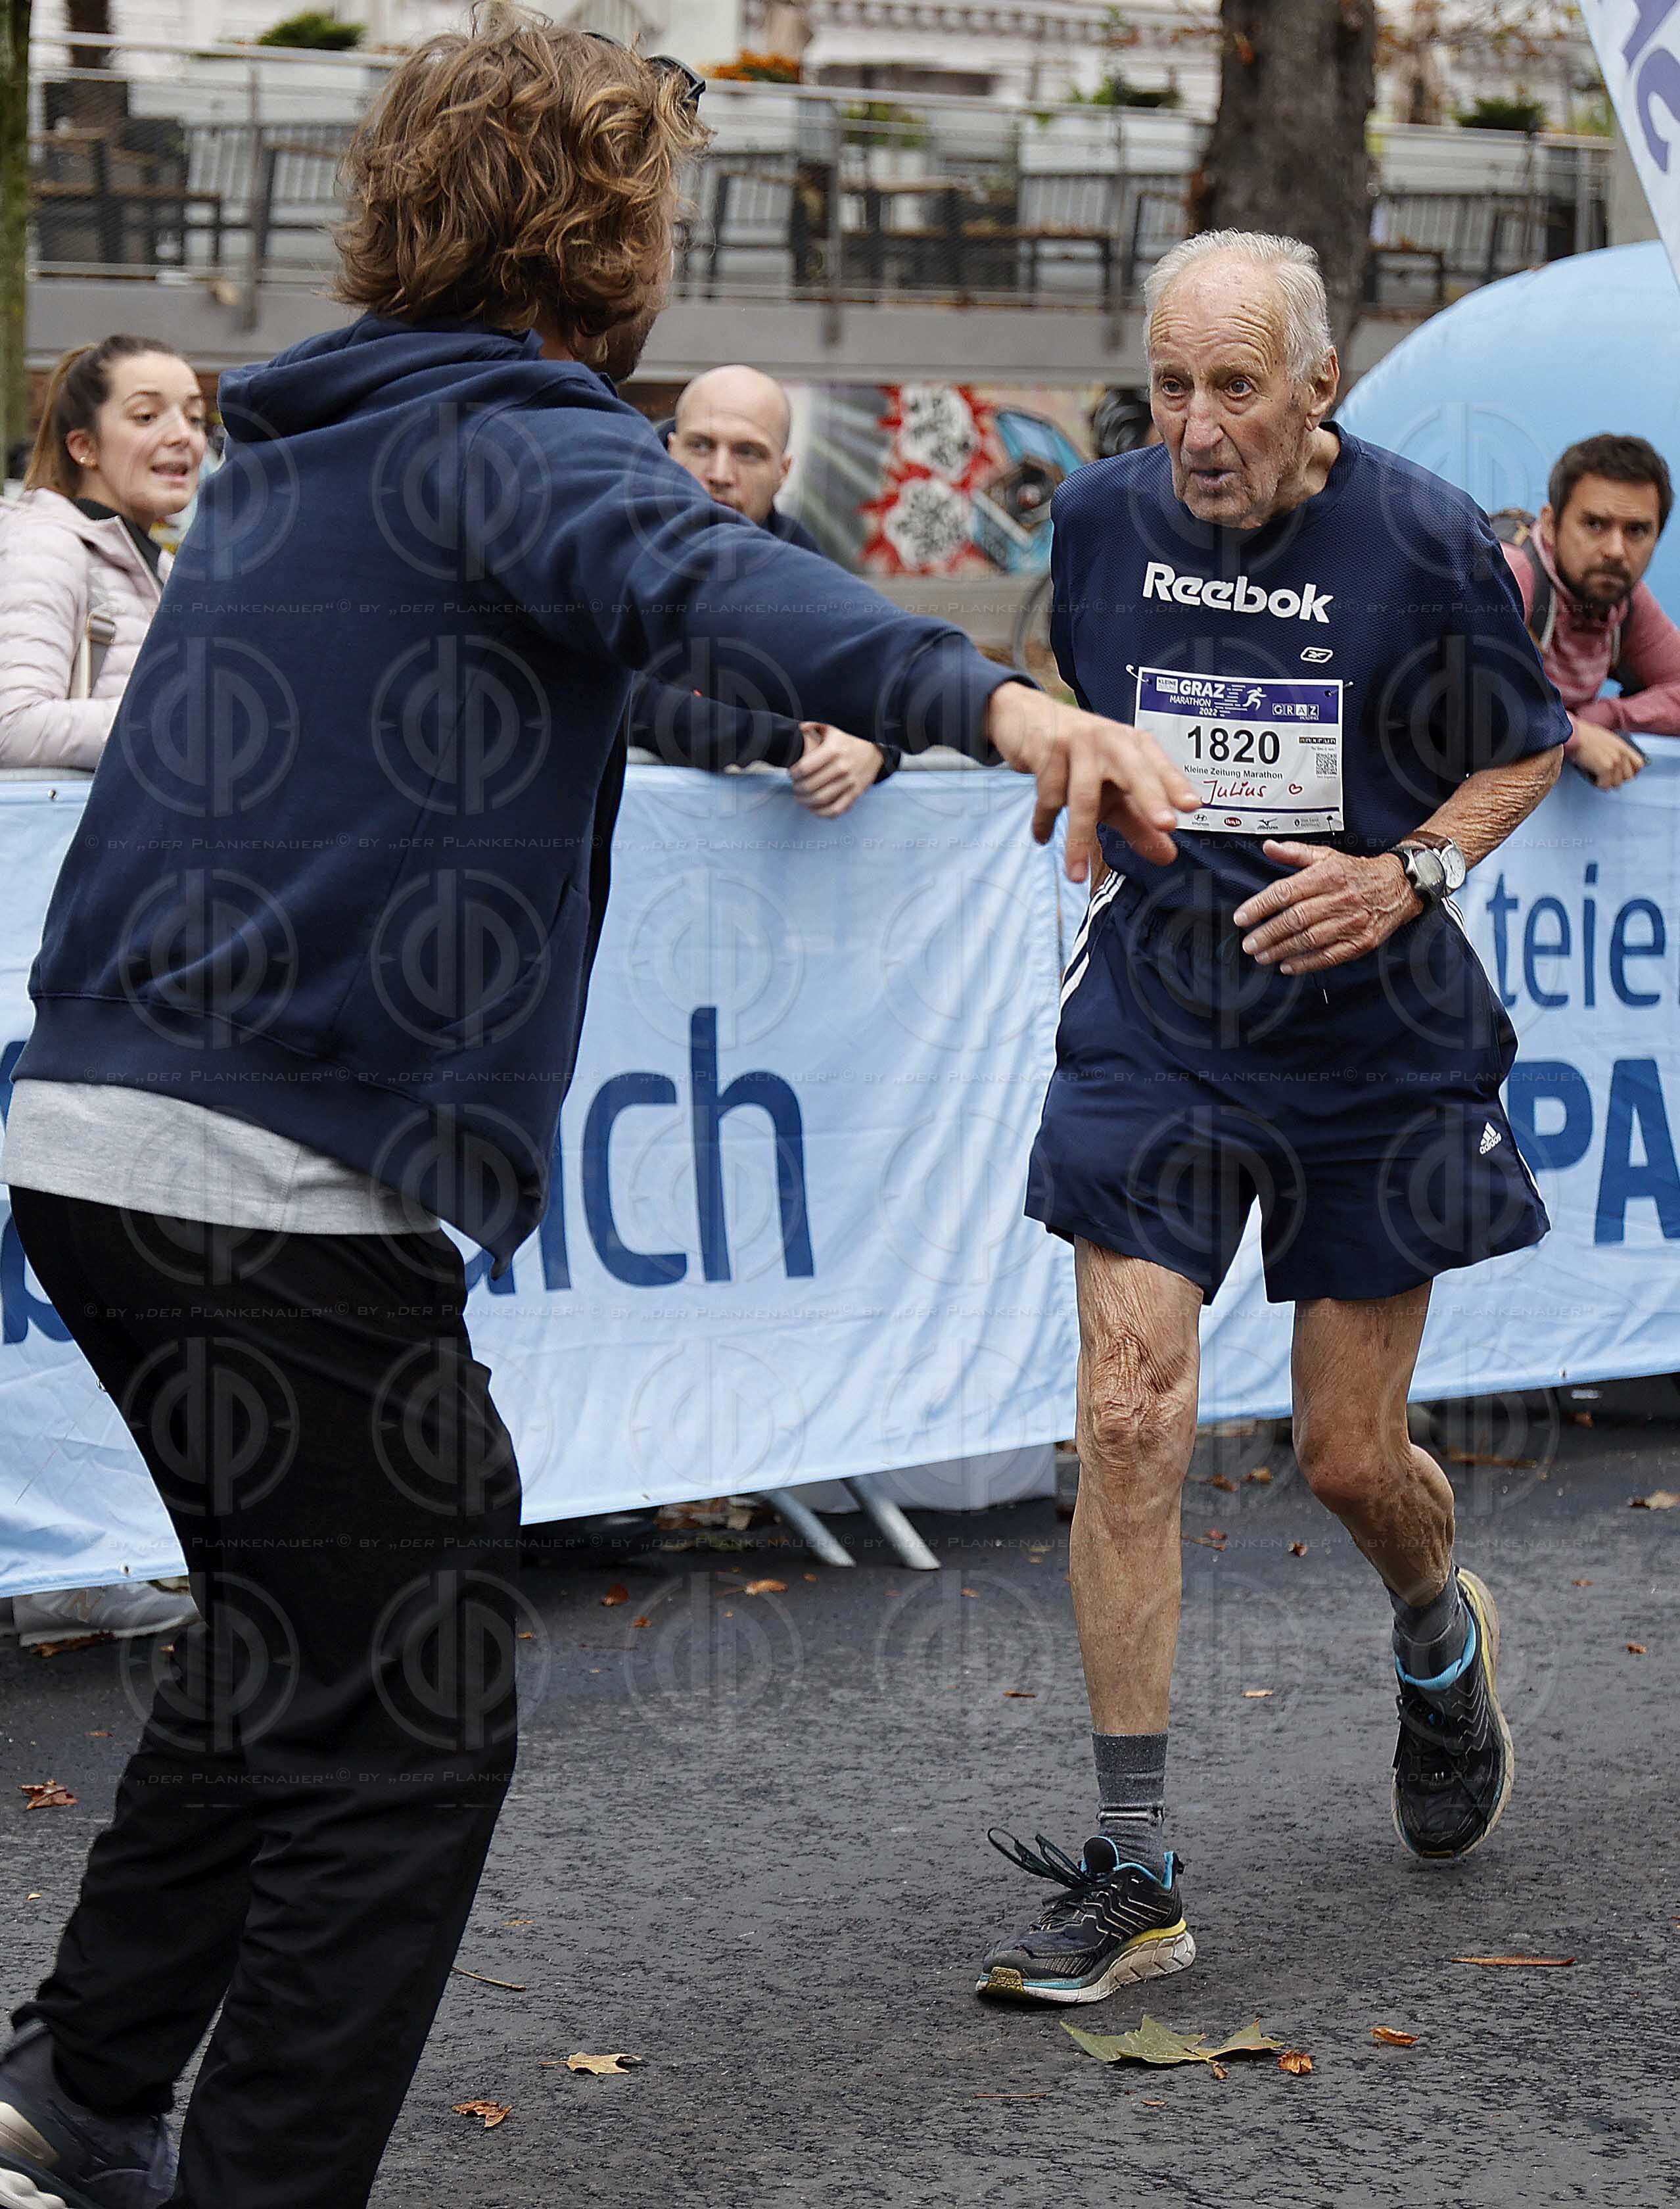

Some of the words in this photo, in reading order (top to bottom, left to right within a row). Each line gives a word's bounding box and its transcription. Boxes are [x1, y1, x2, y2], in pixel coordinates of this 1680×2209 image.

[1142, 561, 1334, 623] Reebok
[1179, 680, 1226, 699] GRAZ
[1169, 695, 1211, 707] MARATHON
[1272, 703, 1319, 716] GRAZ
[1199, 707, 1218, 717] 2022
[1188, 725, 1280, 765] 1820
[1184, 765, 1208, 774] Kleine
[1210, 768, 1241, 778] Zeitung
[1243, 771, 1283, 779] Marathon
[1486, 863, 1680, 1009] teie
[464, 1007, 814, 1296] ich
